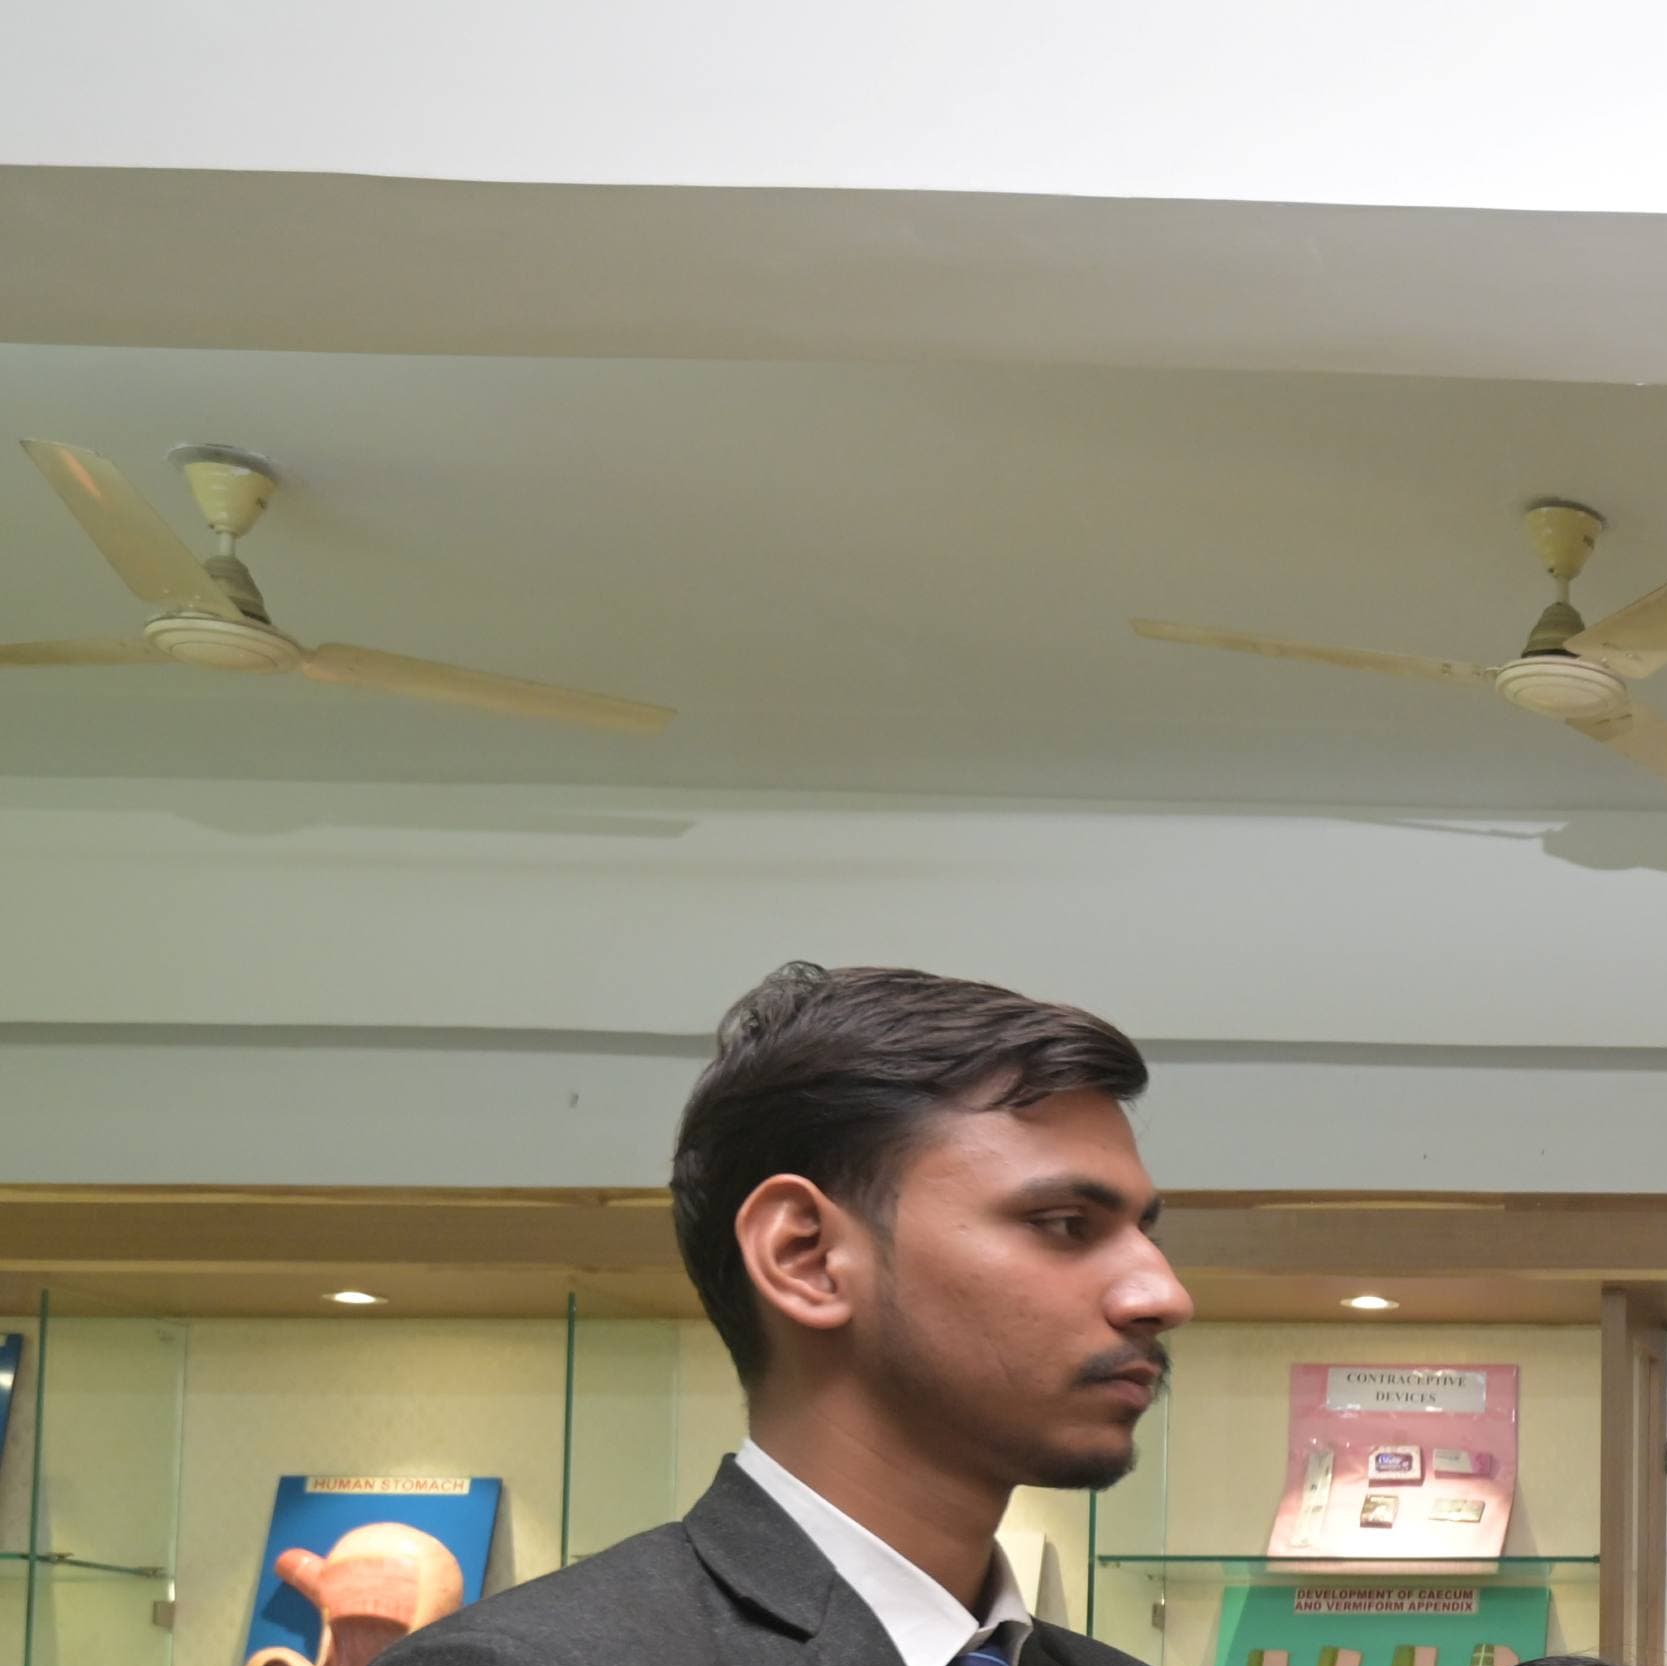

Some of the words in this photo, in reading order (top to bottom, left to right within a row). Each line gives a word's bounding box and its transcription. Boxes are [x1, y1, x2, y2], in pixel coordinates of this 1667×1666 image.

[1346, 1372, 1467, 1388] CONTRACEPTIVE
[1375, 1391, 1437, 1404] DEVICES
[313, 1479, 376, 1491] HUMAN
[380, 1479, 465, 1492] STOMACH
[1297, 1589, 1394, 1600] DEVELOPMENT
[1397, 1589, 1413, 1600] OF
[1418, 1589, 1473, 1600] CAECUM
[1295, 1601, 1322, 1612] AND
[1326, 1601, 1404, 1612] VERMIFORM
[1408, 1601, 1473, 1612] APPENDIX
